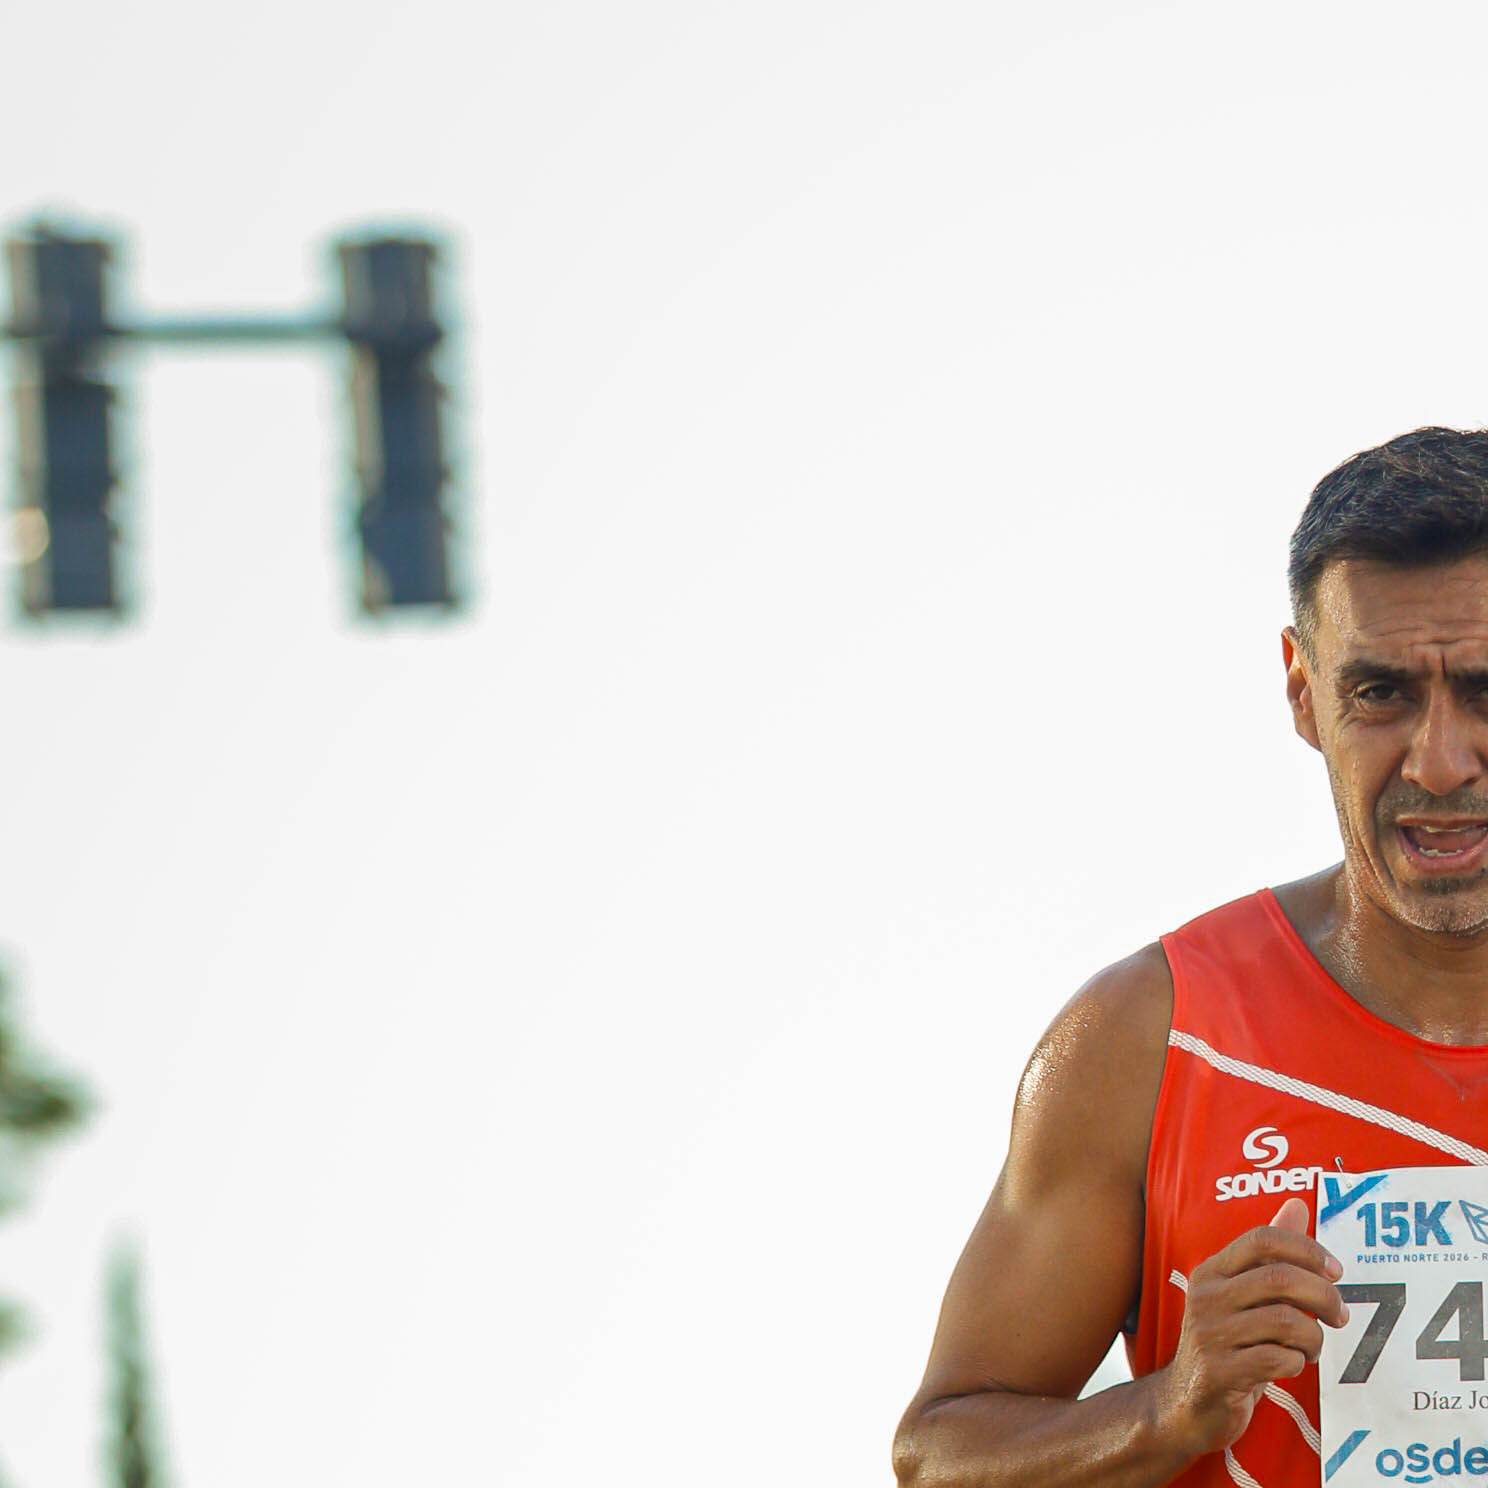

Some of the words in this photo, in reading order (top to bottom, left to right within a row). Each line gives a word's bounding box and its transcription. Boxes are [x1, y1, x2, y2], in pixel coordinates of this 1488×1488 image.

[1356, 1201, 1453, 1248] 15K
[1356, 1253, 1400, 1264] PUERTO
[1403, 1252, 1440, 1263] NORTE
[1443, 1252, 1470, 1262] 2026
[1413, 1390, 1463, 1411] Díaz
